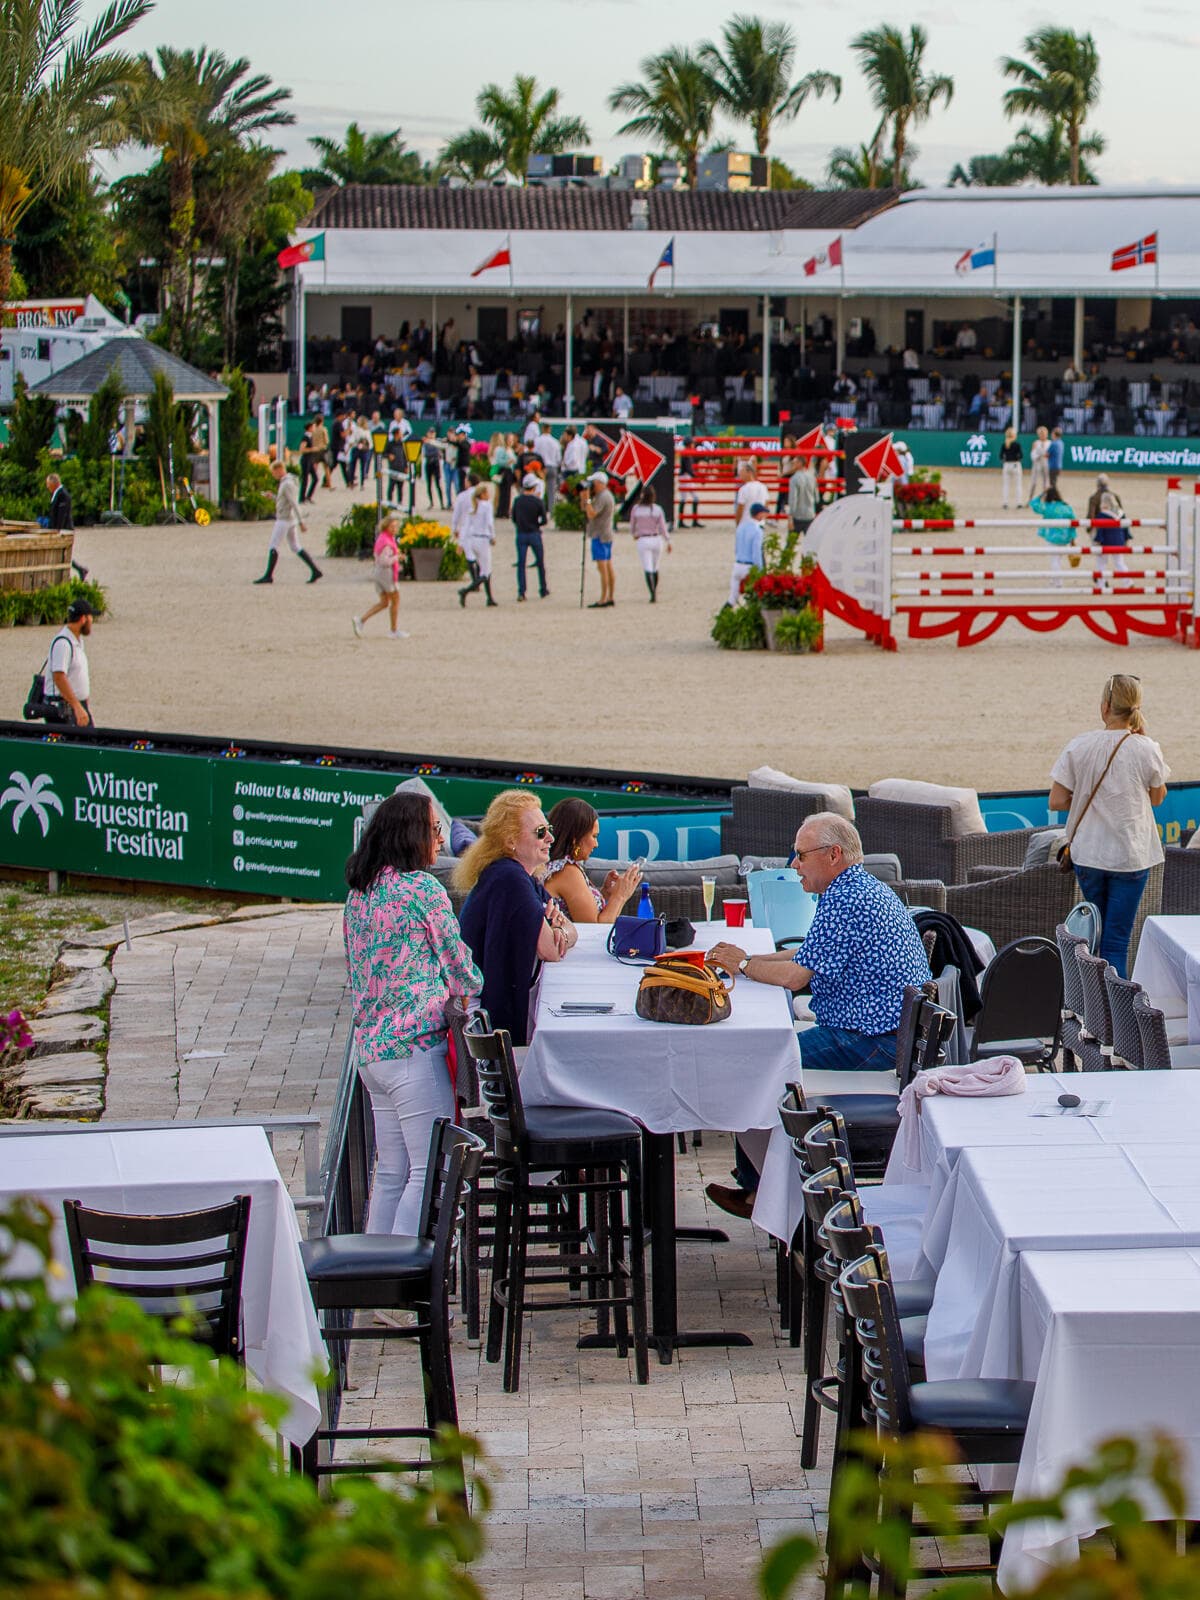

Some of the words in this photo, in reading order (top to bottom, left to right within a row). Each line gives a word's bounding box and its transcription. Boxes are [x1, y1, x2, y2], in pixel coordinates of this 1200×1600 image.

[960, 450, 991, 466] WEF
[1071, 446, 1123, 464] Winter
[85, 771, 158, 802] Winter
[234, 781, 276, 797] Follow
[276, 785, 291, 800] Us
[292, 787, 301, 800] &
[303, 788, 341, 804] Share
[74, 796, 189, 832] Equestrian
[105, 828, 183, 860] Festival
